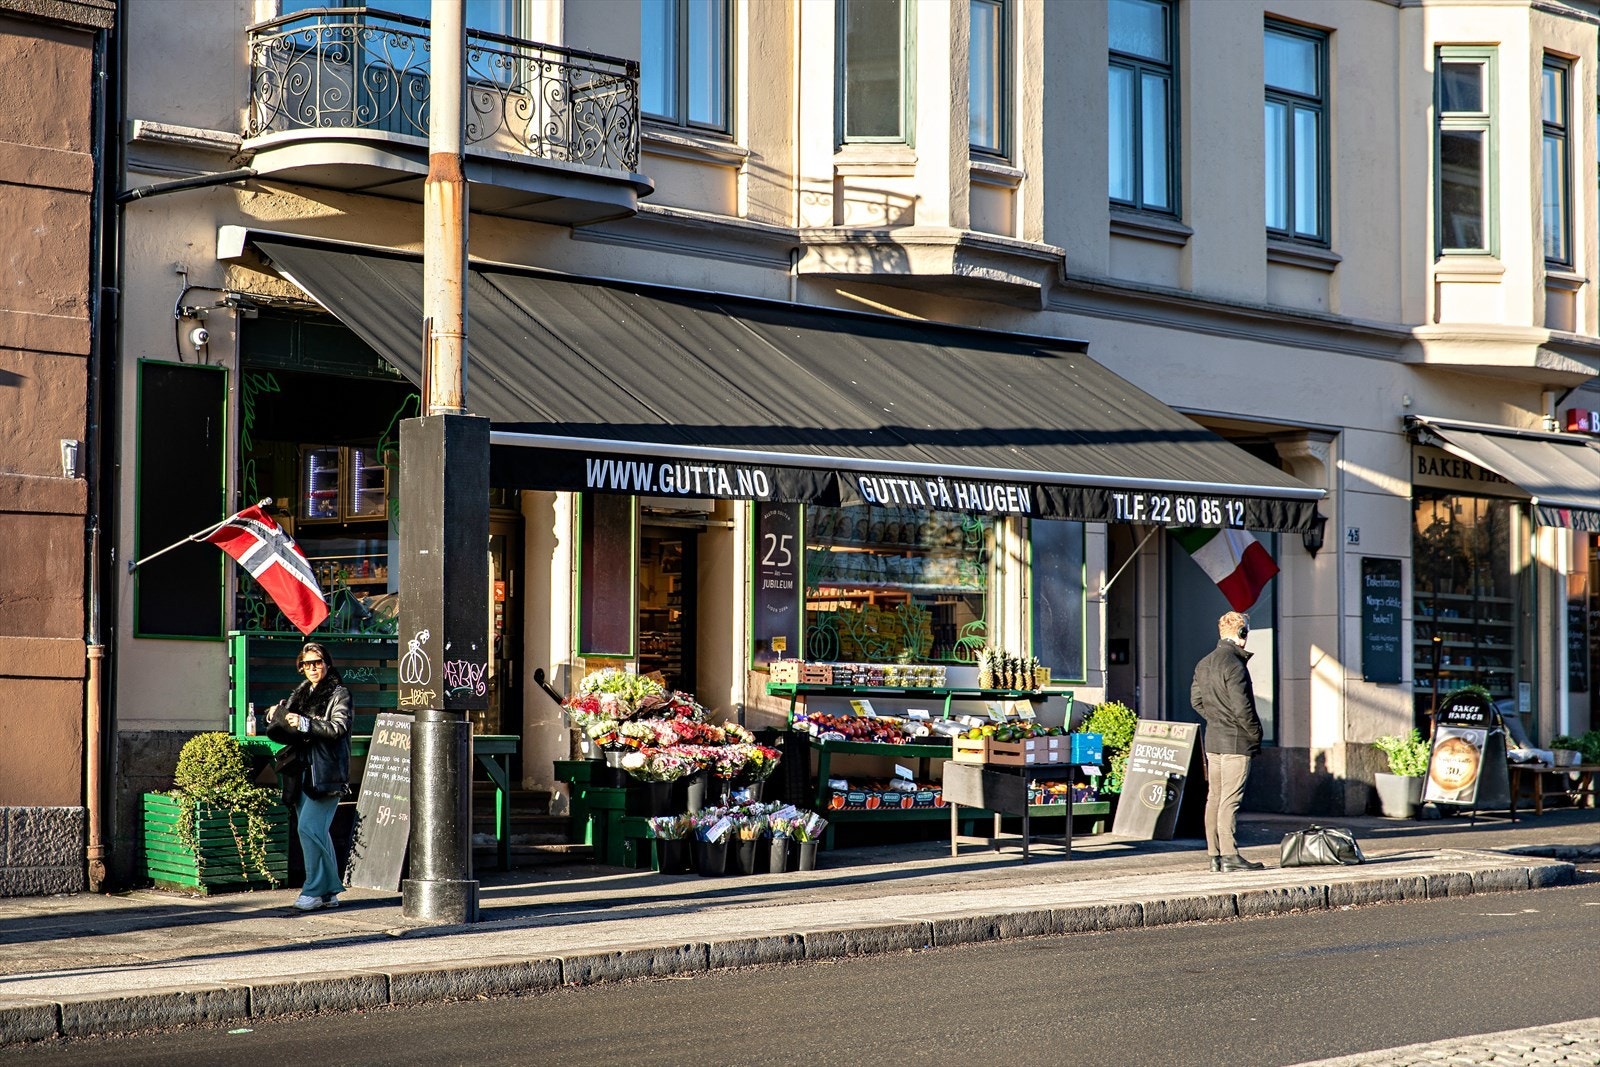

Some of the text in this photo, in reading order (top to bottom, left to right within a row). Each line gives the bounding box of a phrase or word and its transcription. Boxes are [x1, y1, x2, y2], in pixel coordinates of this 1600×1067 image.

[586, 458, 769, 497] WWW.GUTTA.NO
[1417, 456, 1473, 480] BAKER
[858, 476, 1032, 513] GUTTA PÅ HAUGEN
[1113, 494, 1244, 526] TLF. 22 60 85 12
[762, 533, 793, 567] 25
[1347, 529, 1359, 542] 45
[762, 579, 793, 590] JUBILEUM
